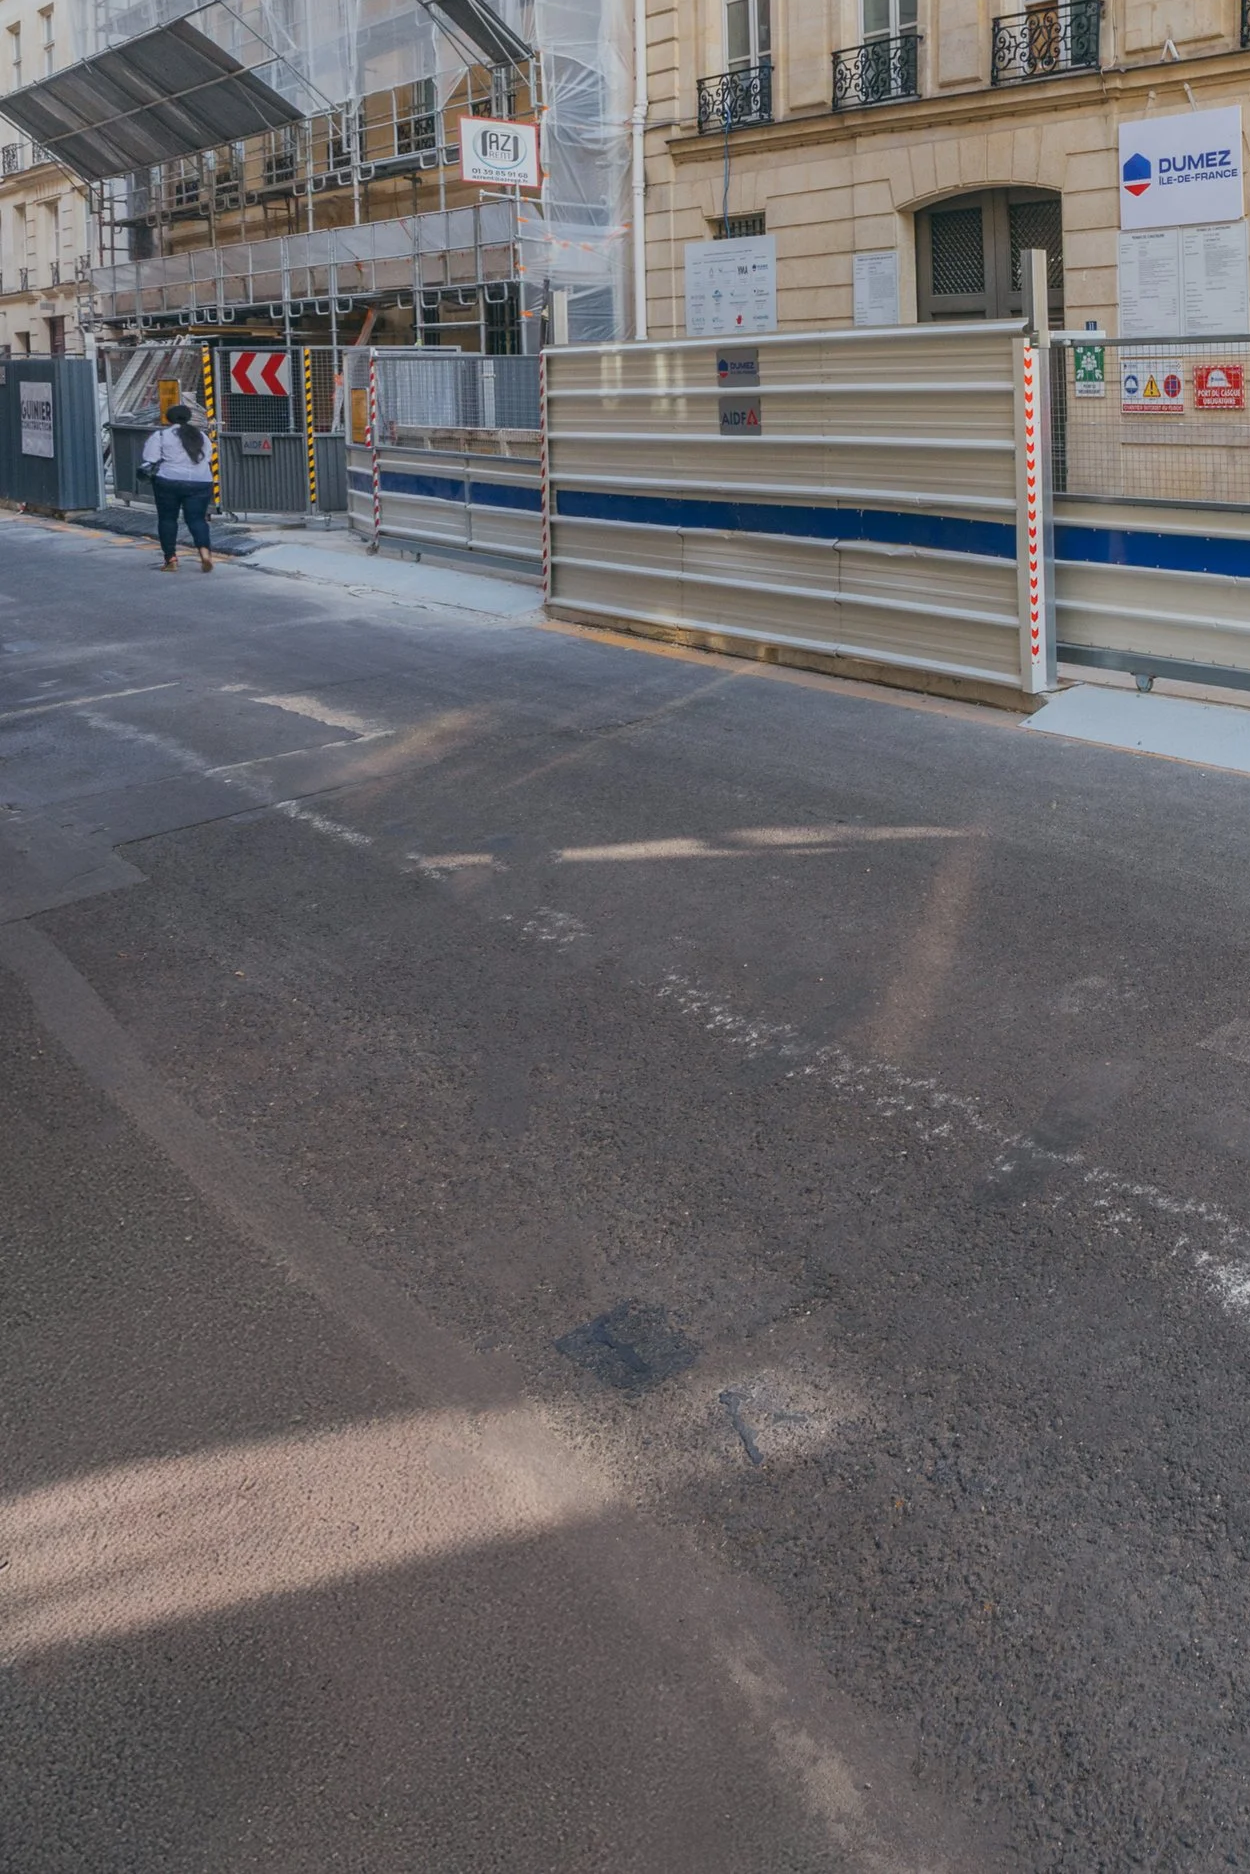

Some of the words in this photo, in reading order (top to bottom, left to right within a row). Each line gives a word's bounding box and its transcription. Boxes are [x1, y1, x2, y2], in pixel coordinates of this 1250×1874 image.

[488, 132, 512, 152] AZ
[1159, 149, 1232, 174] DUMEZ
[1159, 168, 1239, 186] ÎLE-DE-FRANCE
[730, 361, 755, 370] DUMEZ
[22, 400, 51, 421] GUINIER
